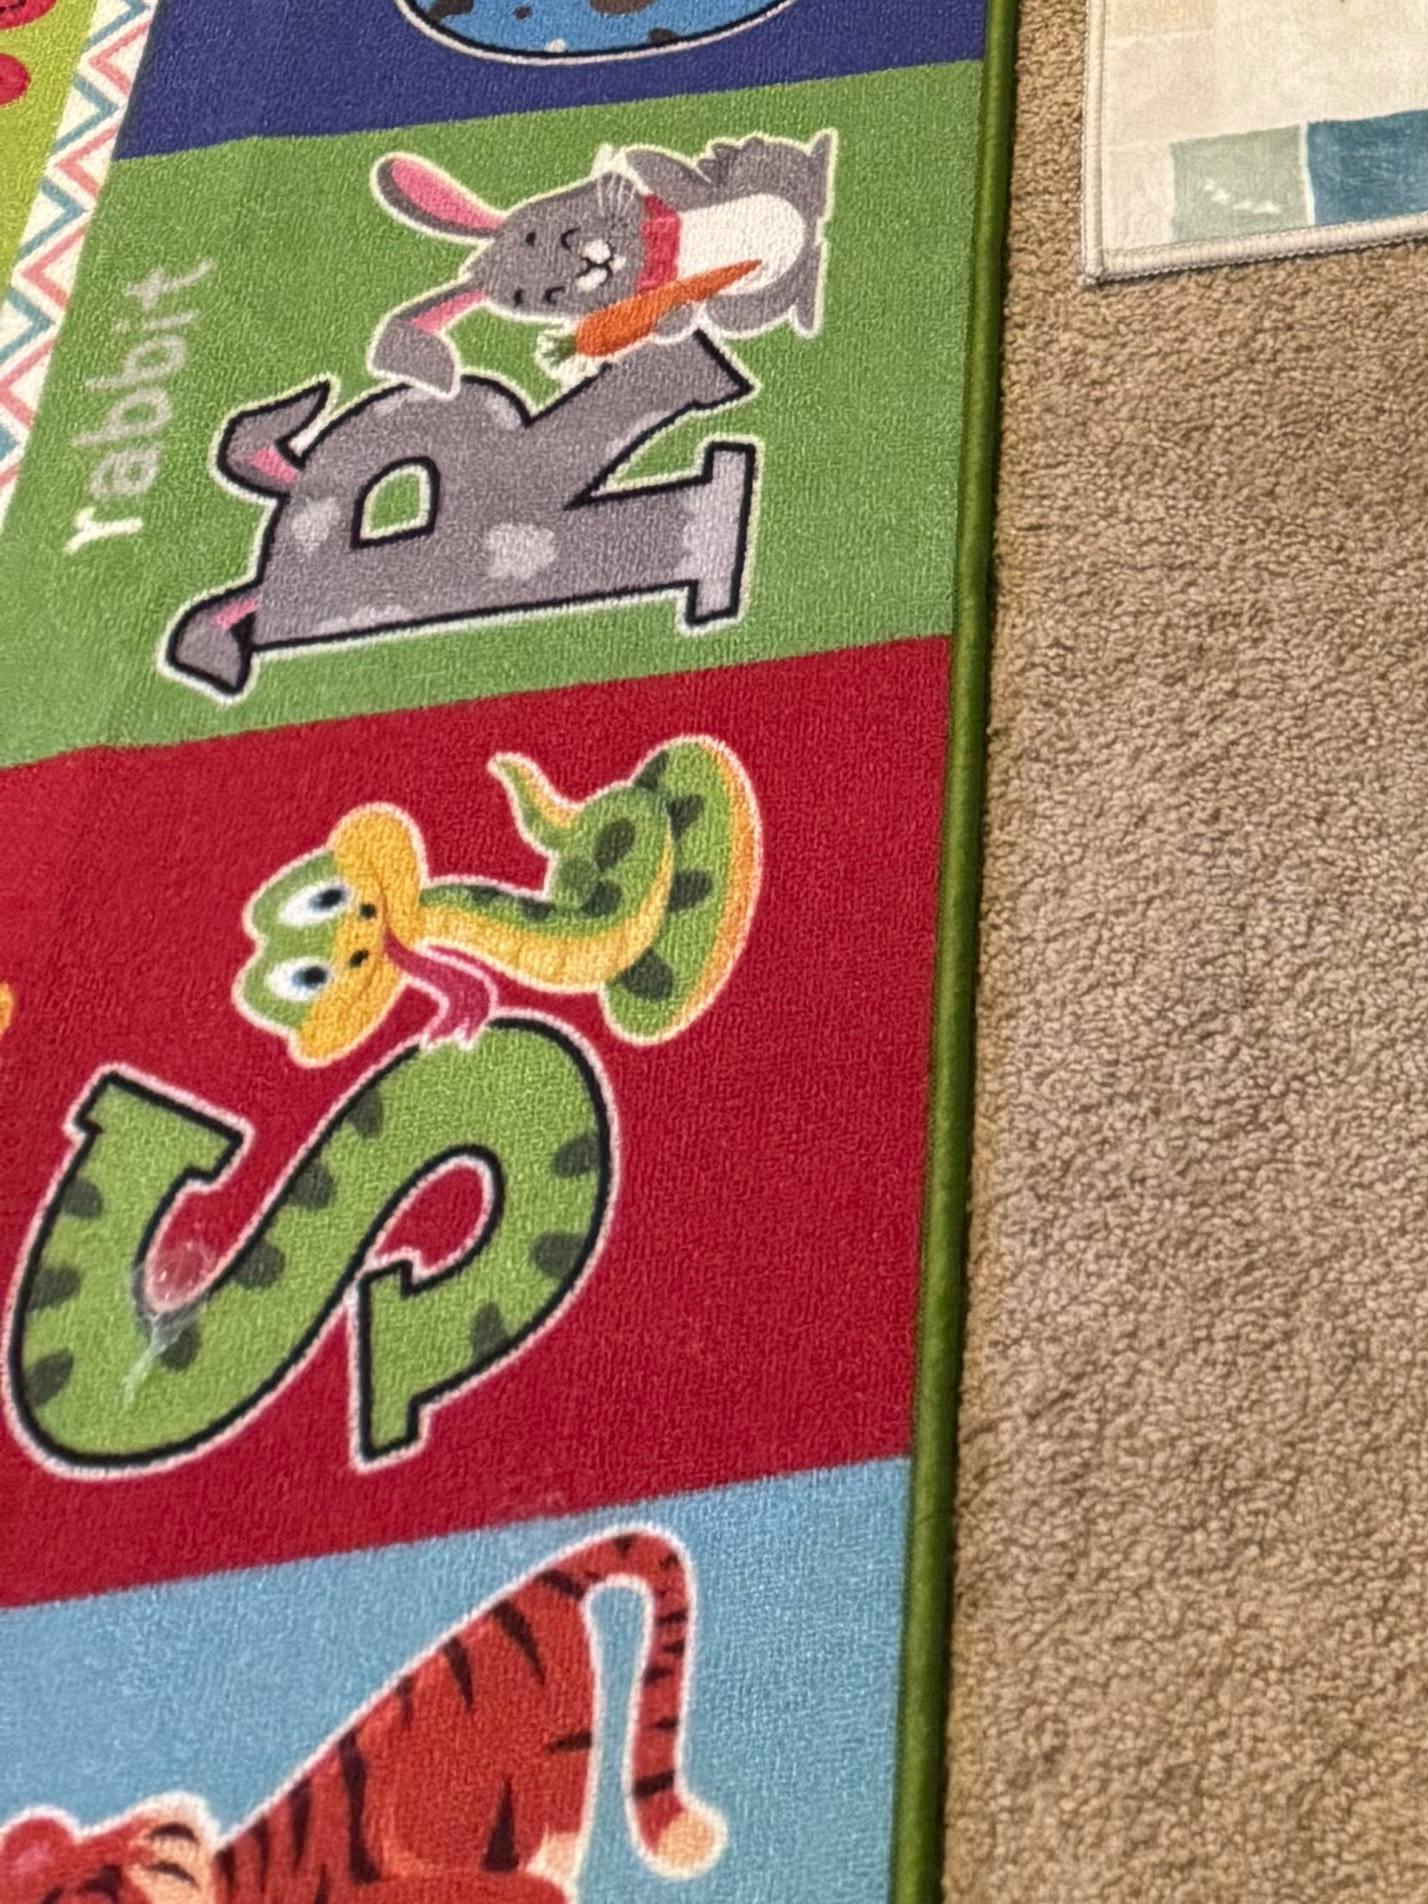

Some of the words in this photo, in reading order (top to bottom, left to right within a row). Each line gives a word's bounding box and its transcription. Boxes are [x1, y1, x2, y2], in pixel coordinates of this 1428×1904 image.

[64, 256, 216, 555] rabbit
[157, 324, 759, 705] R
[5, 1008, 622, 1480] S
